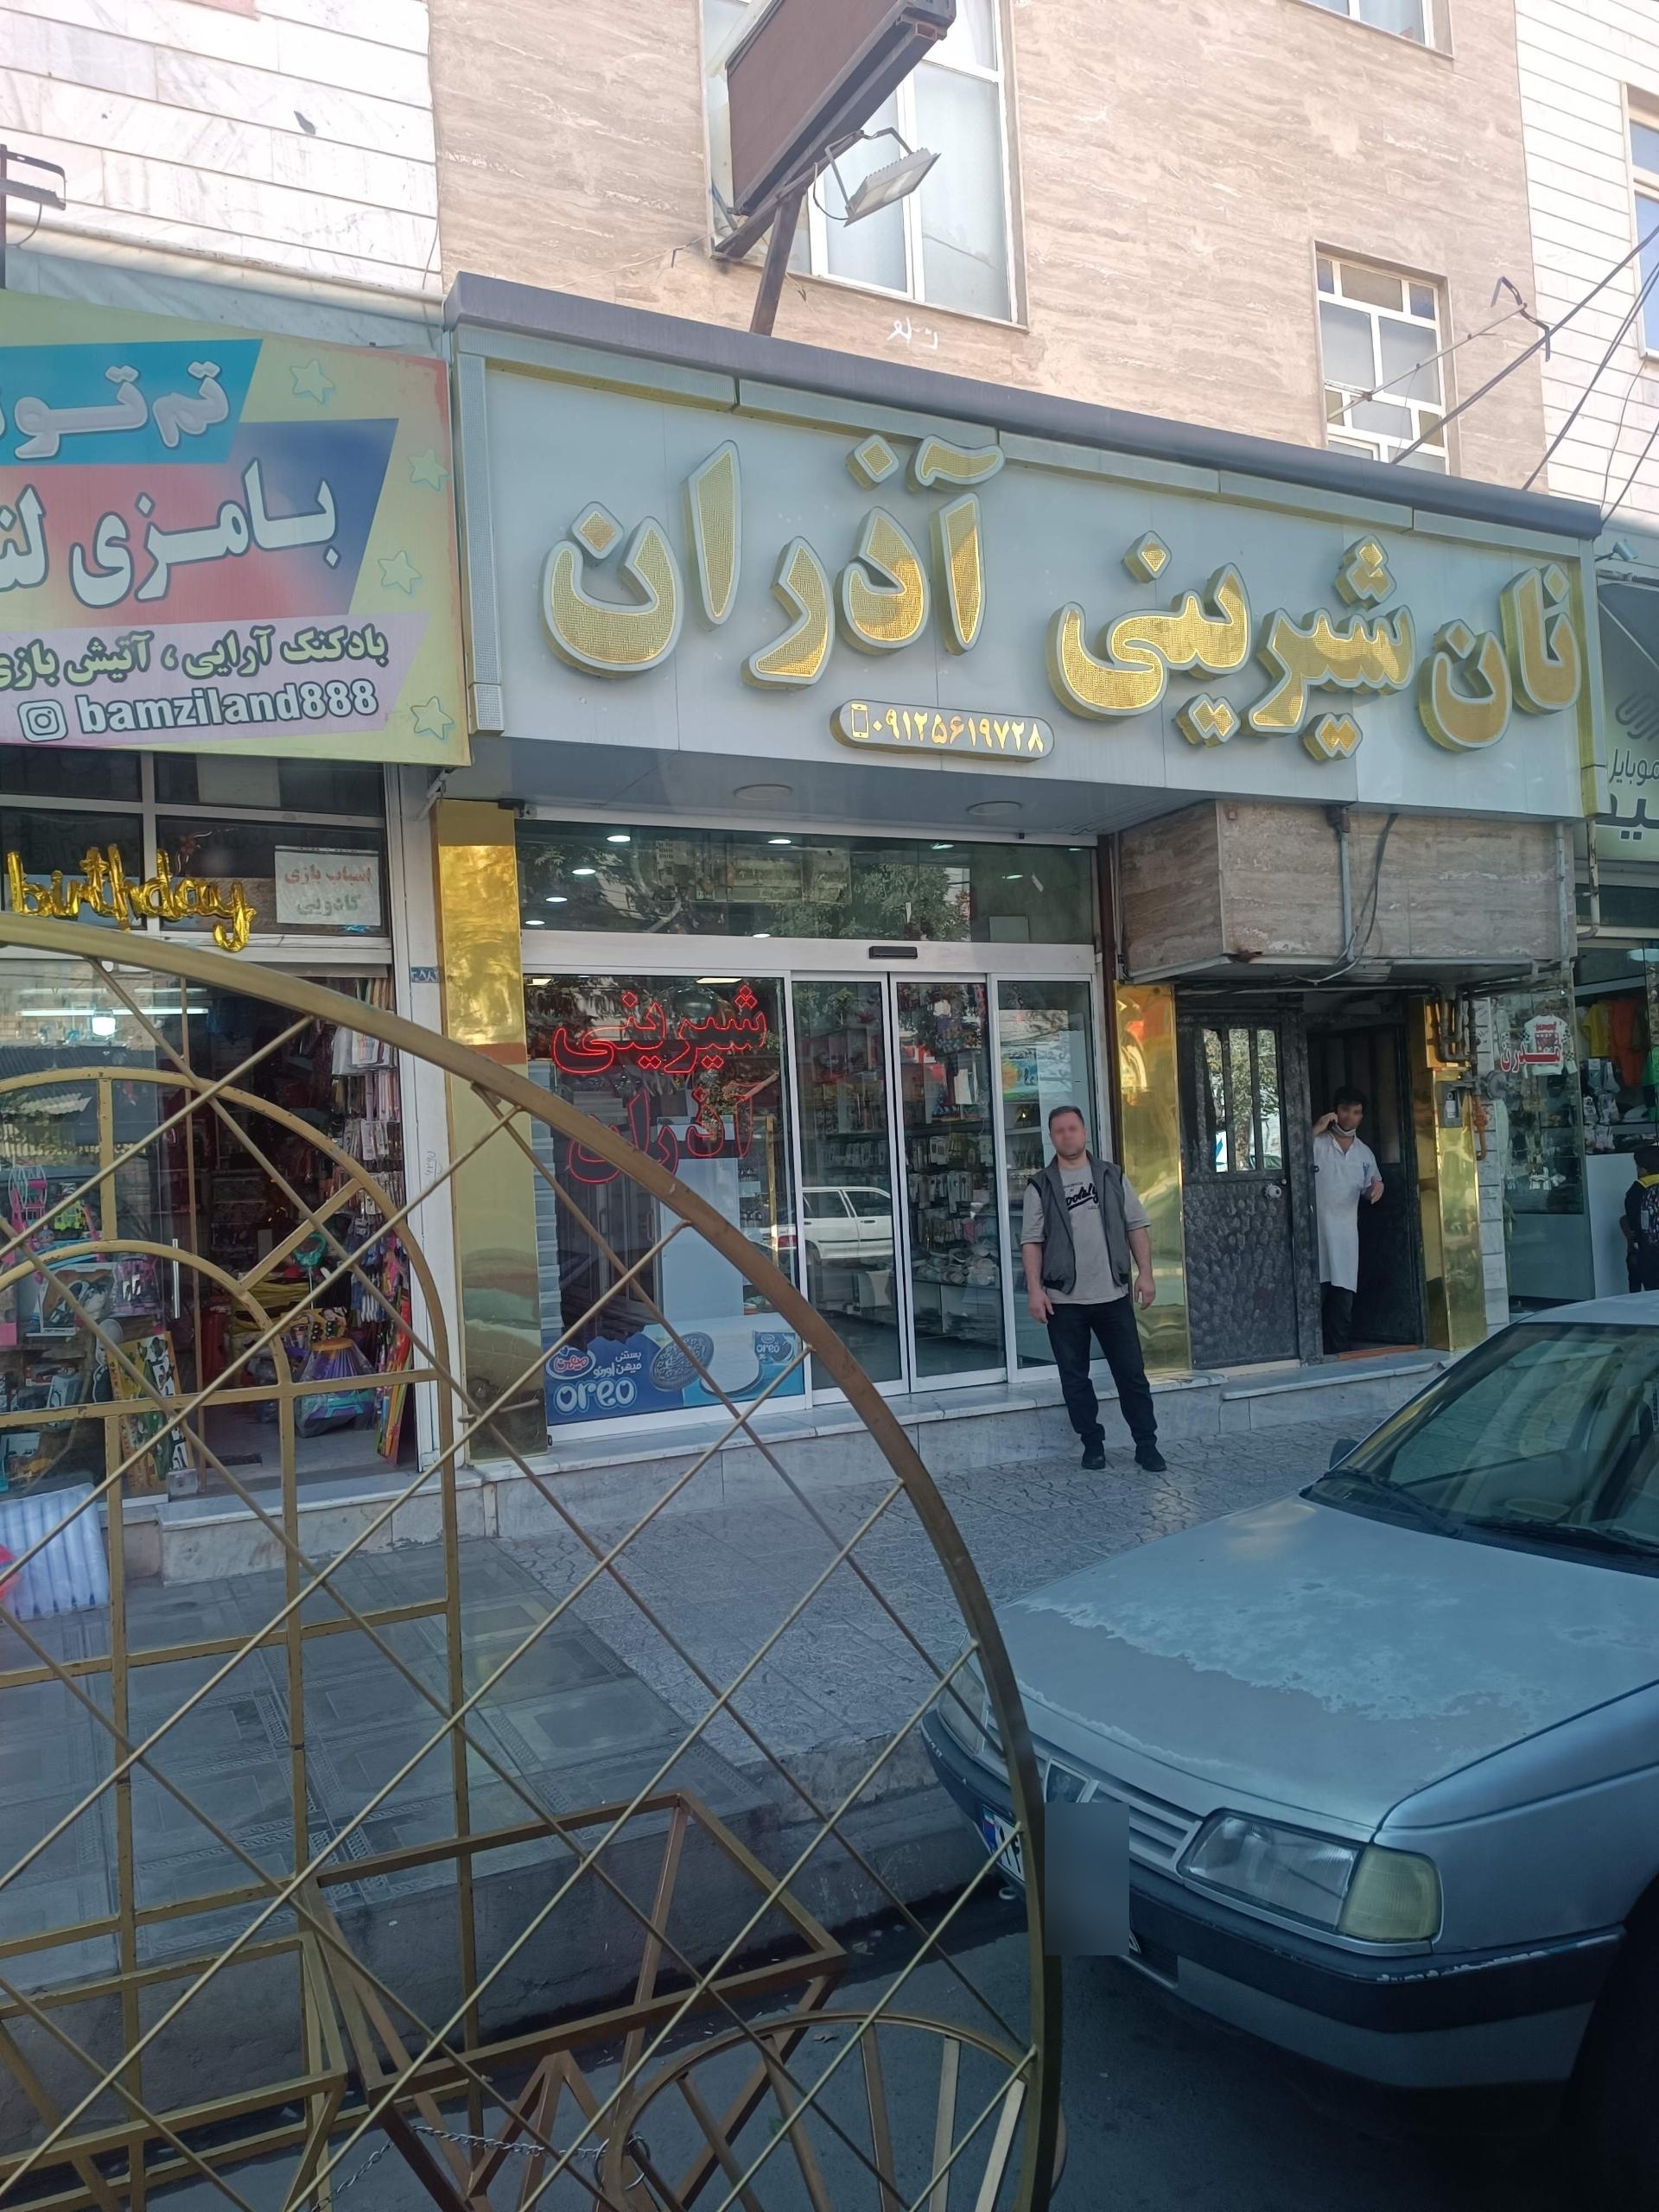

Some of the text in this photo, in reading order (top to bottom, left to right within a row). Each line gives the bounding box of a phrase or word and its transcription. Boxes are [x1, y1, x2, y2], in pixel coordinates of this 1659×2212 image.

[68, 458, 342, 610] بامزی
[540, 434, 1582, 761] نان شیرینی آذران
[63, 630, 156, 687] آتیش
[181, 624, 276, 679] آرایی
[75, 678, 378, 736] bamziland888
[7, 843, 257, 953] birthday
[325, 865, 372, 887] اسباب
[552, 984, 768, 1074] شیرینی
[1500, 1039, 1563, 1073] مدرن
[616, 1363, 643, 1375] میهن
[756, 1344, 780, 1354] oreo
[554, 1377, 636, 1414] oreo
